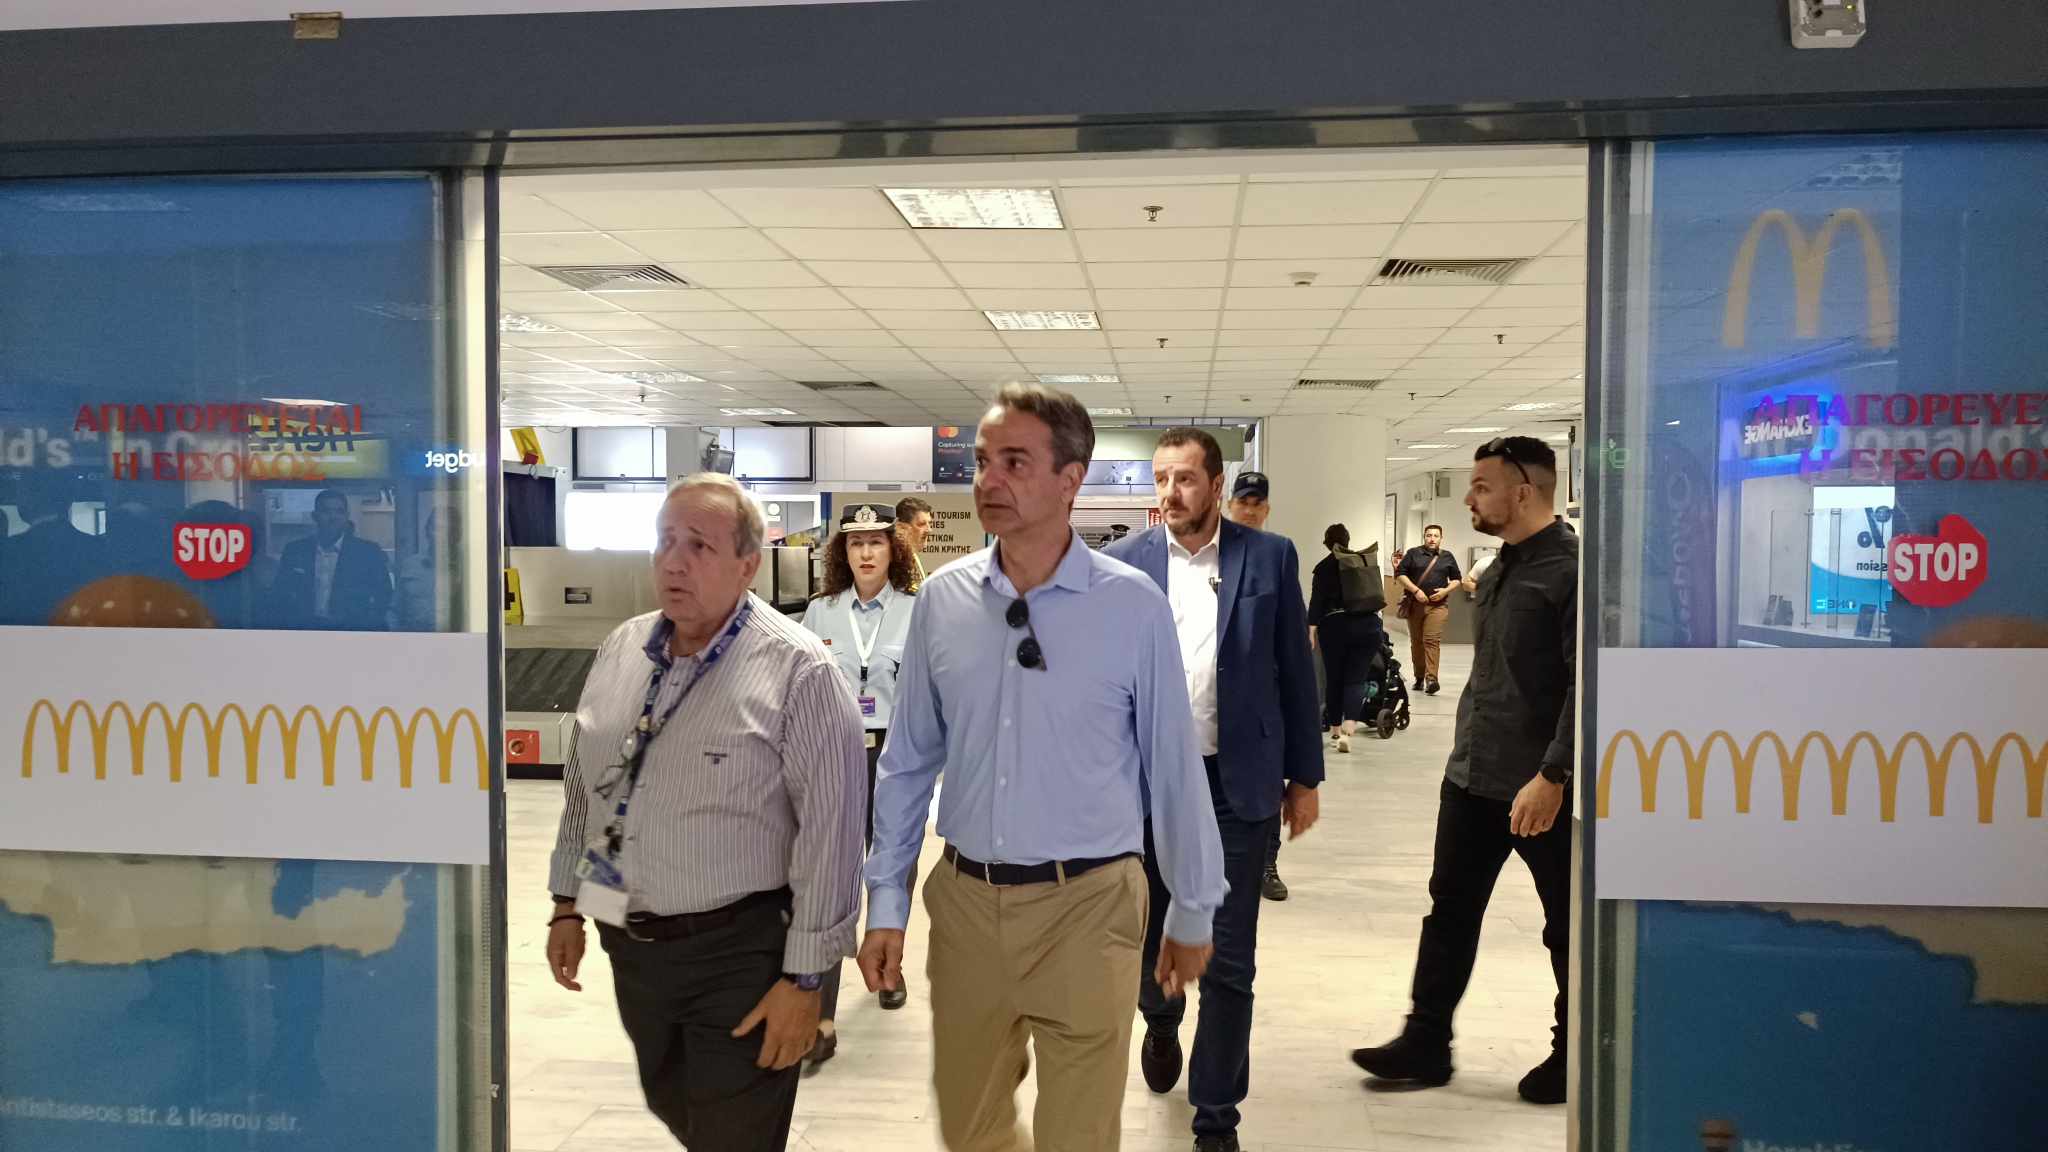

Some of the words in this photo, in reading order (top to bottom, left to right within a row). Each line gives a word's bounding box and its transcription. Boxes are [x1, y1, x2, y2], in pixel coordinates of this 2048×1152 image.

[1753, 392, 2048, 426] ΑΠΑΓΟΡΕΥΕ
[154, 451, 326, 481] ΕΙΣΟΔΟΣ
[937, 511, 971, 520] TOURISM
[178, 528, 245, 564] STOP
[1894, 542, 1979, 582] STOP
[167, 1105, 183, 1127] &
